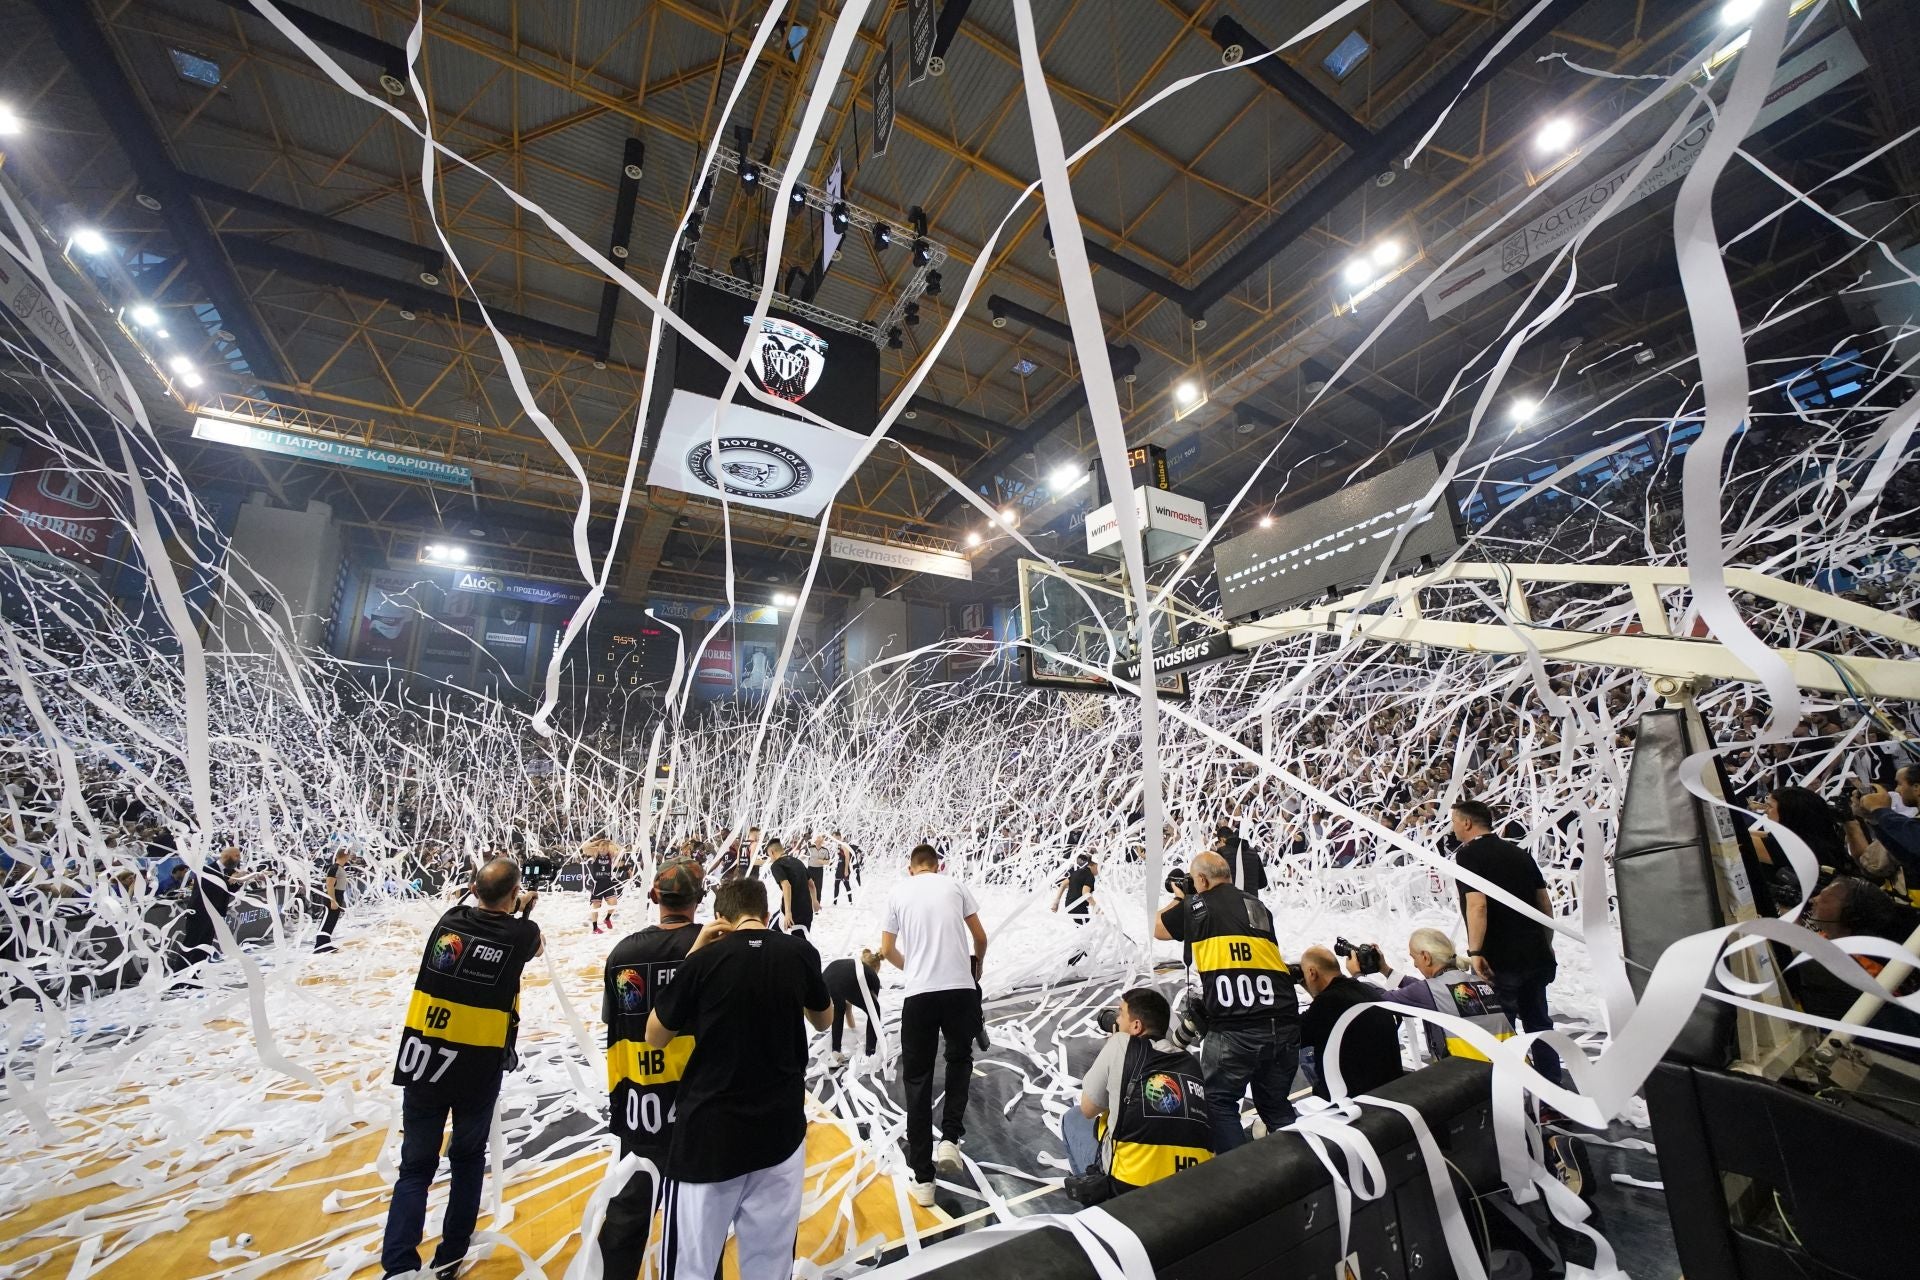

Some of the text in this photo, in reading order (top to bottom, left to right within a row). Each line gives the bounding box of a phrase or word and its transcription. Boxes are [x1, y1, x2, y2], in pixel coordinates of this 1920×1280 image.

[722, 439, 757, 448] PAOK
[772, 446, 801, 465] PAOK
[336, 444, 364, 458] ΤΗΣ
[367, 450, 470, 477] ΚΑΘΑΡΙΟΤΗΤΑΣ
[17, 509, 97, 543] MORRIS
[1155, 505, 1203, 526] winmasters
[833, 542, 915, 566] ticketmaster
[459, 573, 497, 592] Διός
[513, 586, 551, 597] ΠΡΟΣΤΑΣΙΑ
[1127, 641, 1210, 678] wmasters
[472, 944, 504, 963] FIBA
[1229, 942, 1252, 962] HB
[1215, 974, 1275, 1007] 009
[425, 1005, 451, 1030] HB
[638, 1050, 665, 1076] HB
[1186, 1080, 1205, 1101] FIBA
